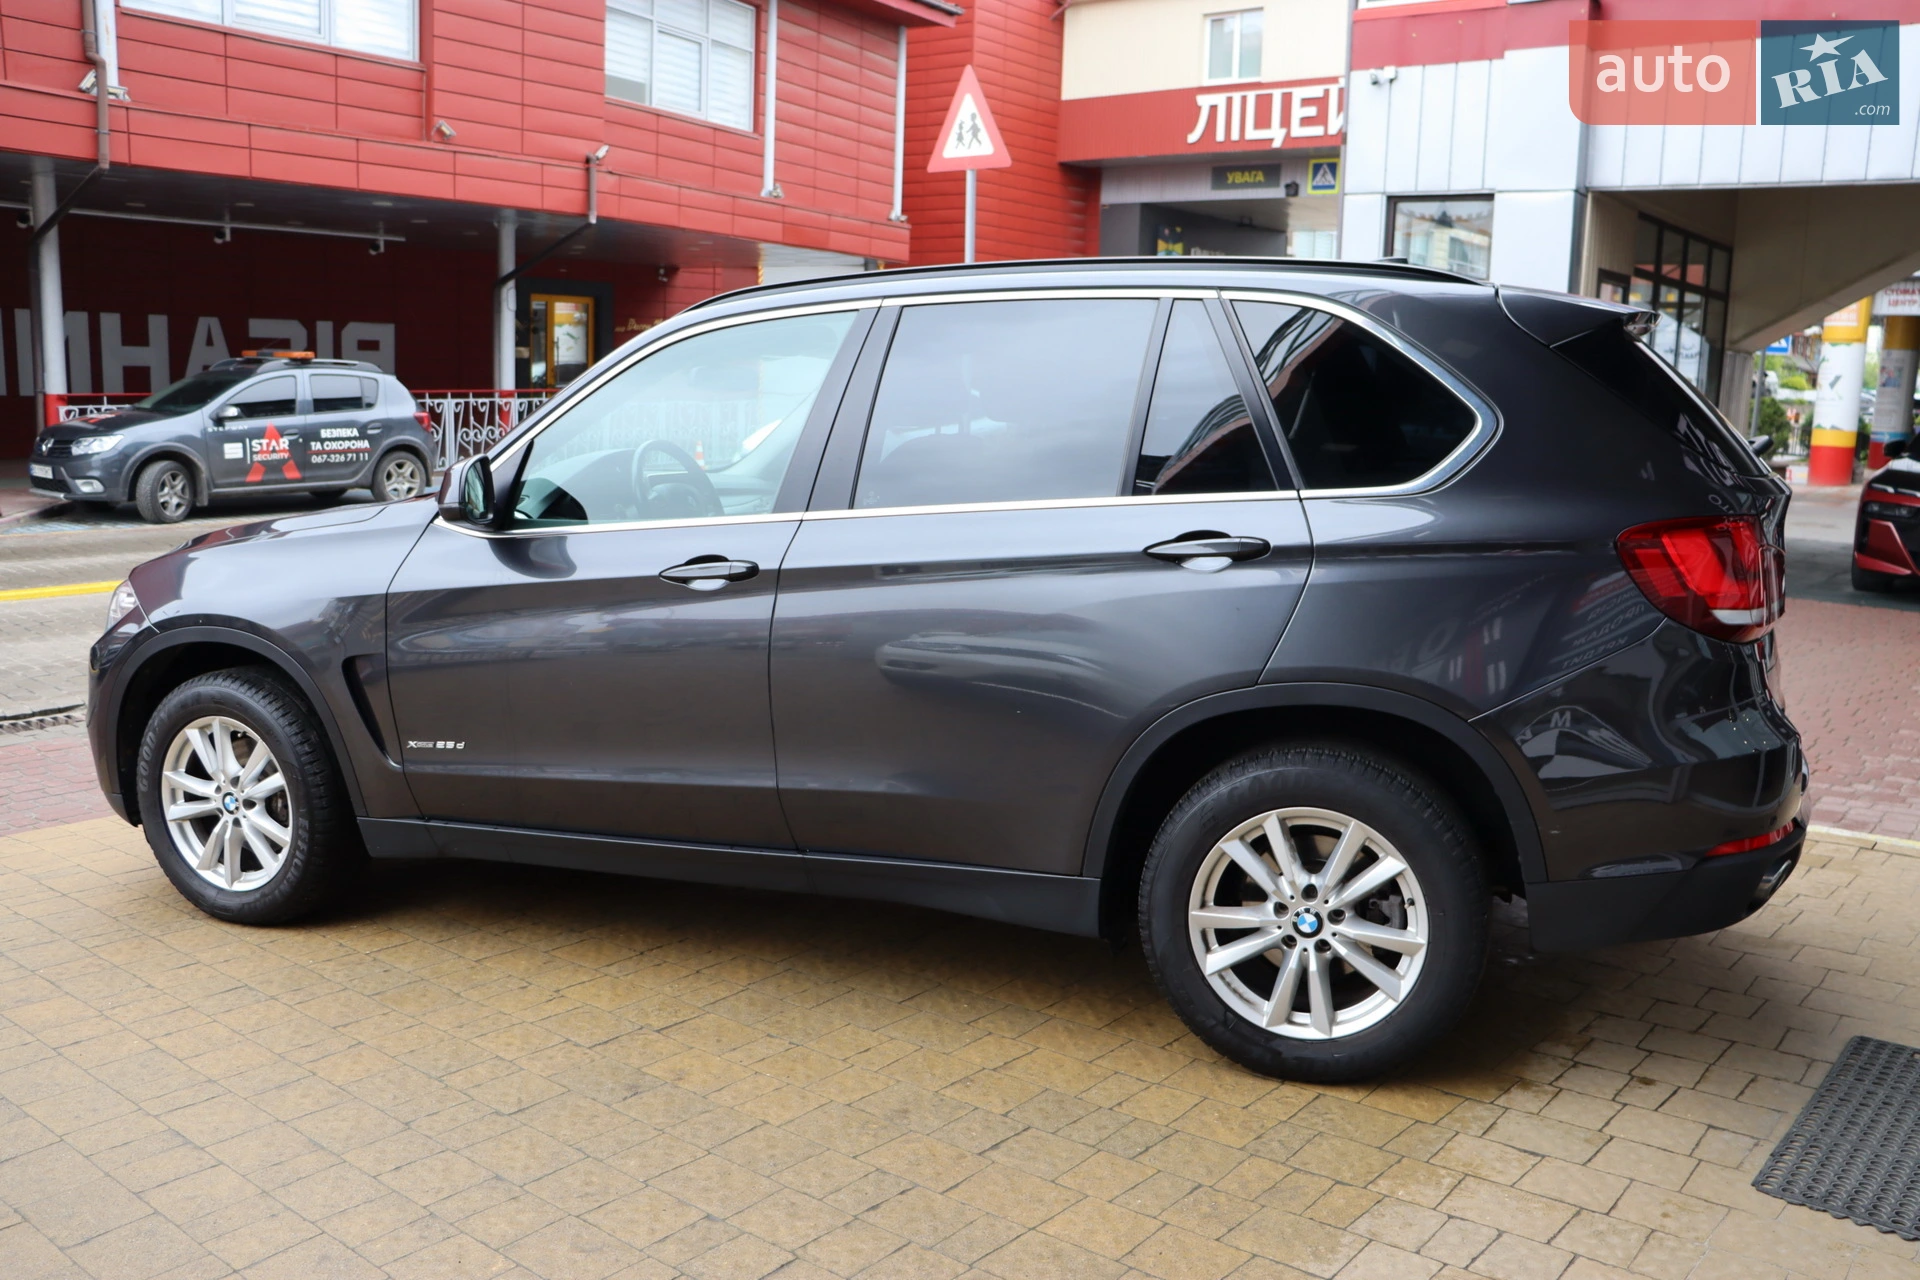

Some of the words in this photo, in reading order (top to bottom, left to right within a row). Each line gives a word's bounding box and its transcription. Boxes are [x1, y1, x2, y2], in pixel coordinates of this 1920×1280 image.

[1226, 170, 1265, 185] УВАГА
[320, 427, 360, 439] БЕЗПЕКА
[251, 438, 290, 452] STAR
[310, 440, 323, 452] ТА
[323, 439, 371, 451] ОХОРОНА
[252, 452, 291, 462] SECURITY
[311, 452, 346, 464] 067-326
[346, 452, 357, 462] 71
